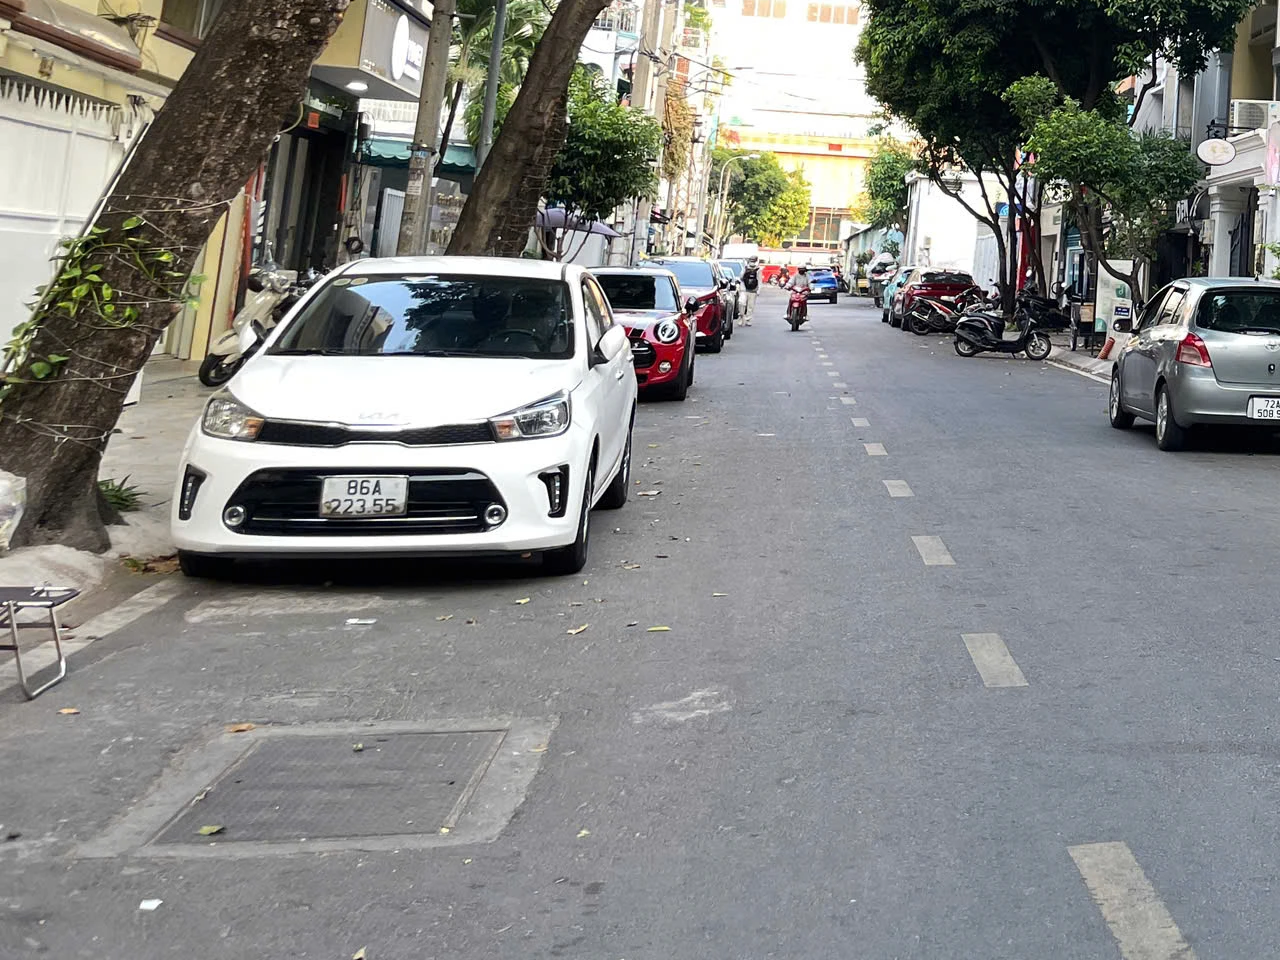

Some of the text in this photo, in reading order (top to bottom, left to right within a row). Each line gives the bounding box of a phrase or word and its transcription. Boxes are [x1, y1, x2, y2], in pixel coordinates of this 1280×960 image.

[1264, 399, 1280, 409] 72A
[347, 479, 382, 495] 86A
[330, 498, 397, 514] 223.55
